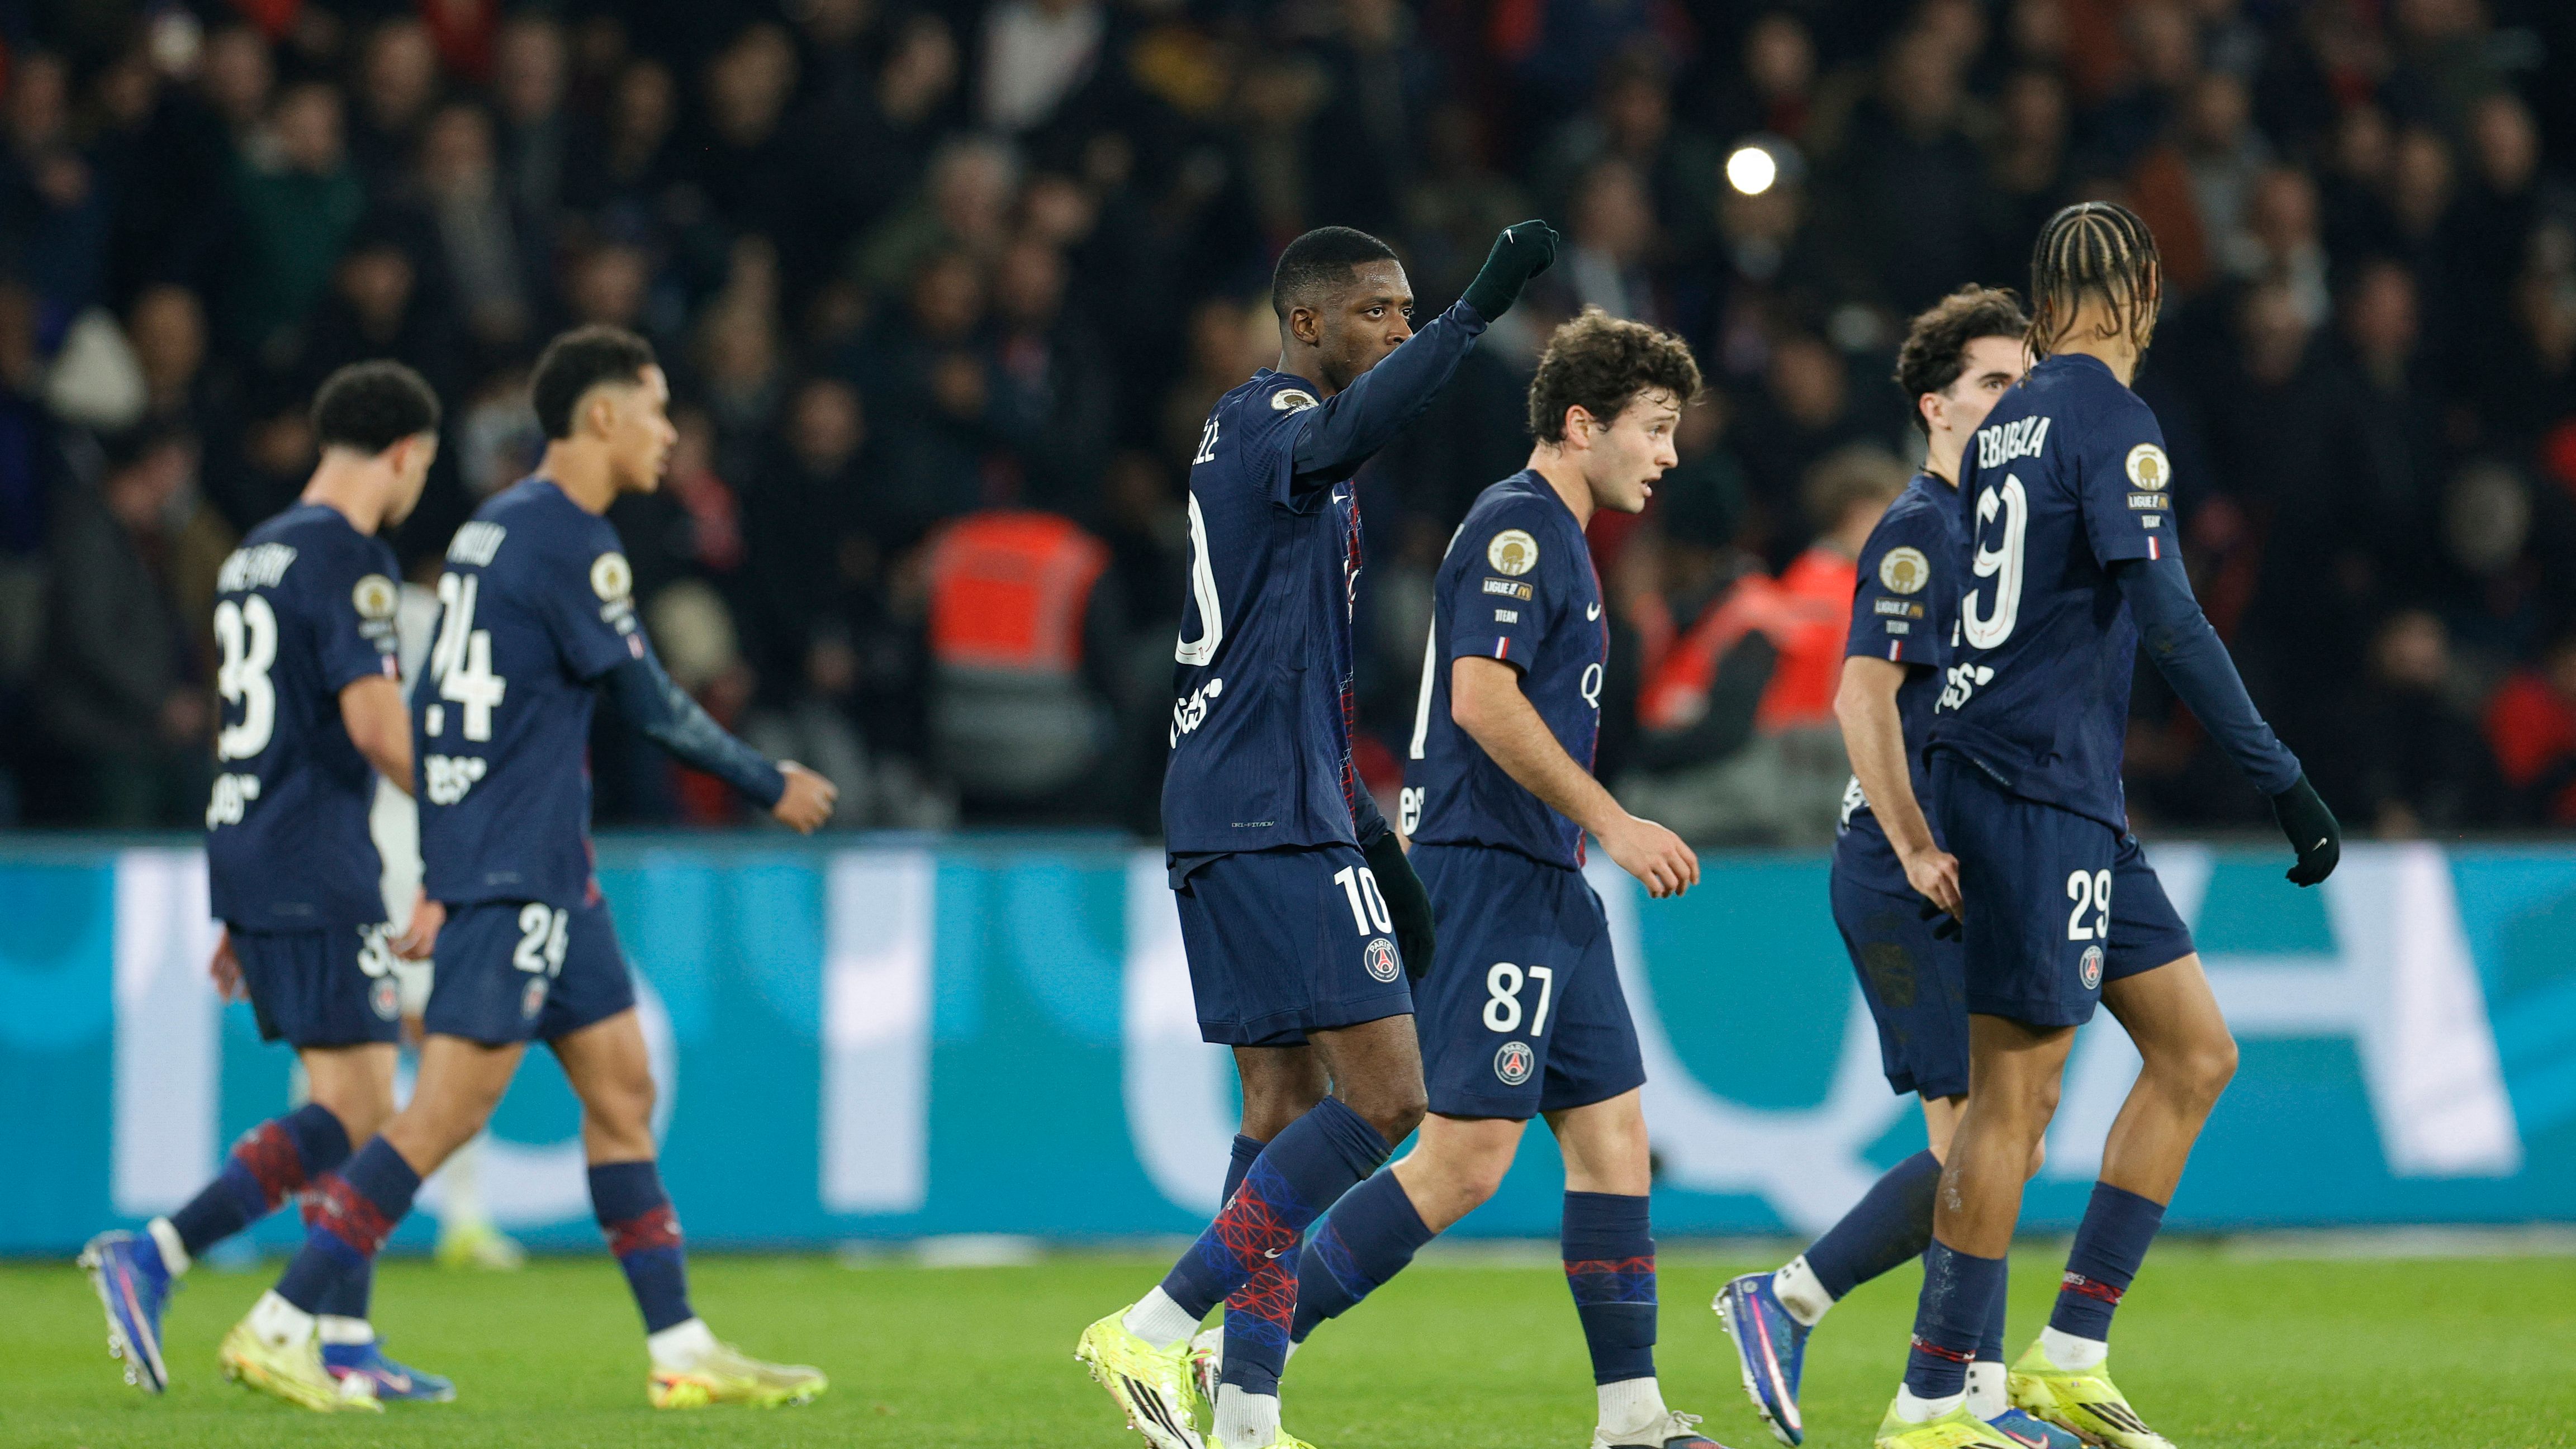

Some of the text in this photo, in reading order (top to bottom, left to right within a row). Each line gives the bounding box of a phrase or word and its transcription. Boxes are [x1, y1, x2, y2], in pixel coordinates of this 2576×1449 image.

[1483, 580, 1510, 594] LIGUE
[1952, 473, 2028, 650] 9
[1334, 866, 1393, 936] 10
[2067, 868, 2112, 941] 29
[1370, 940, 1392, 953] PARIS
[1482, 962, 1553, 1037] 87
